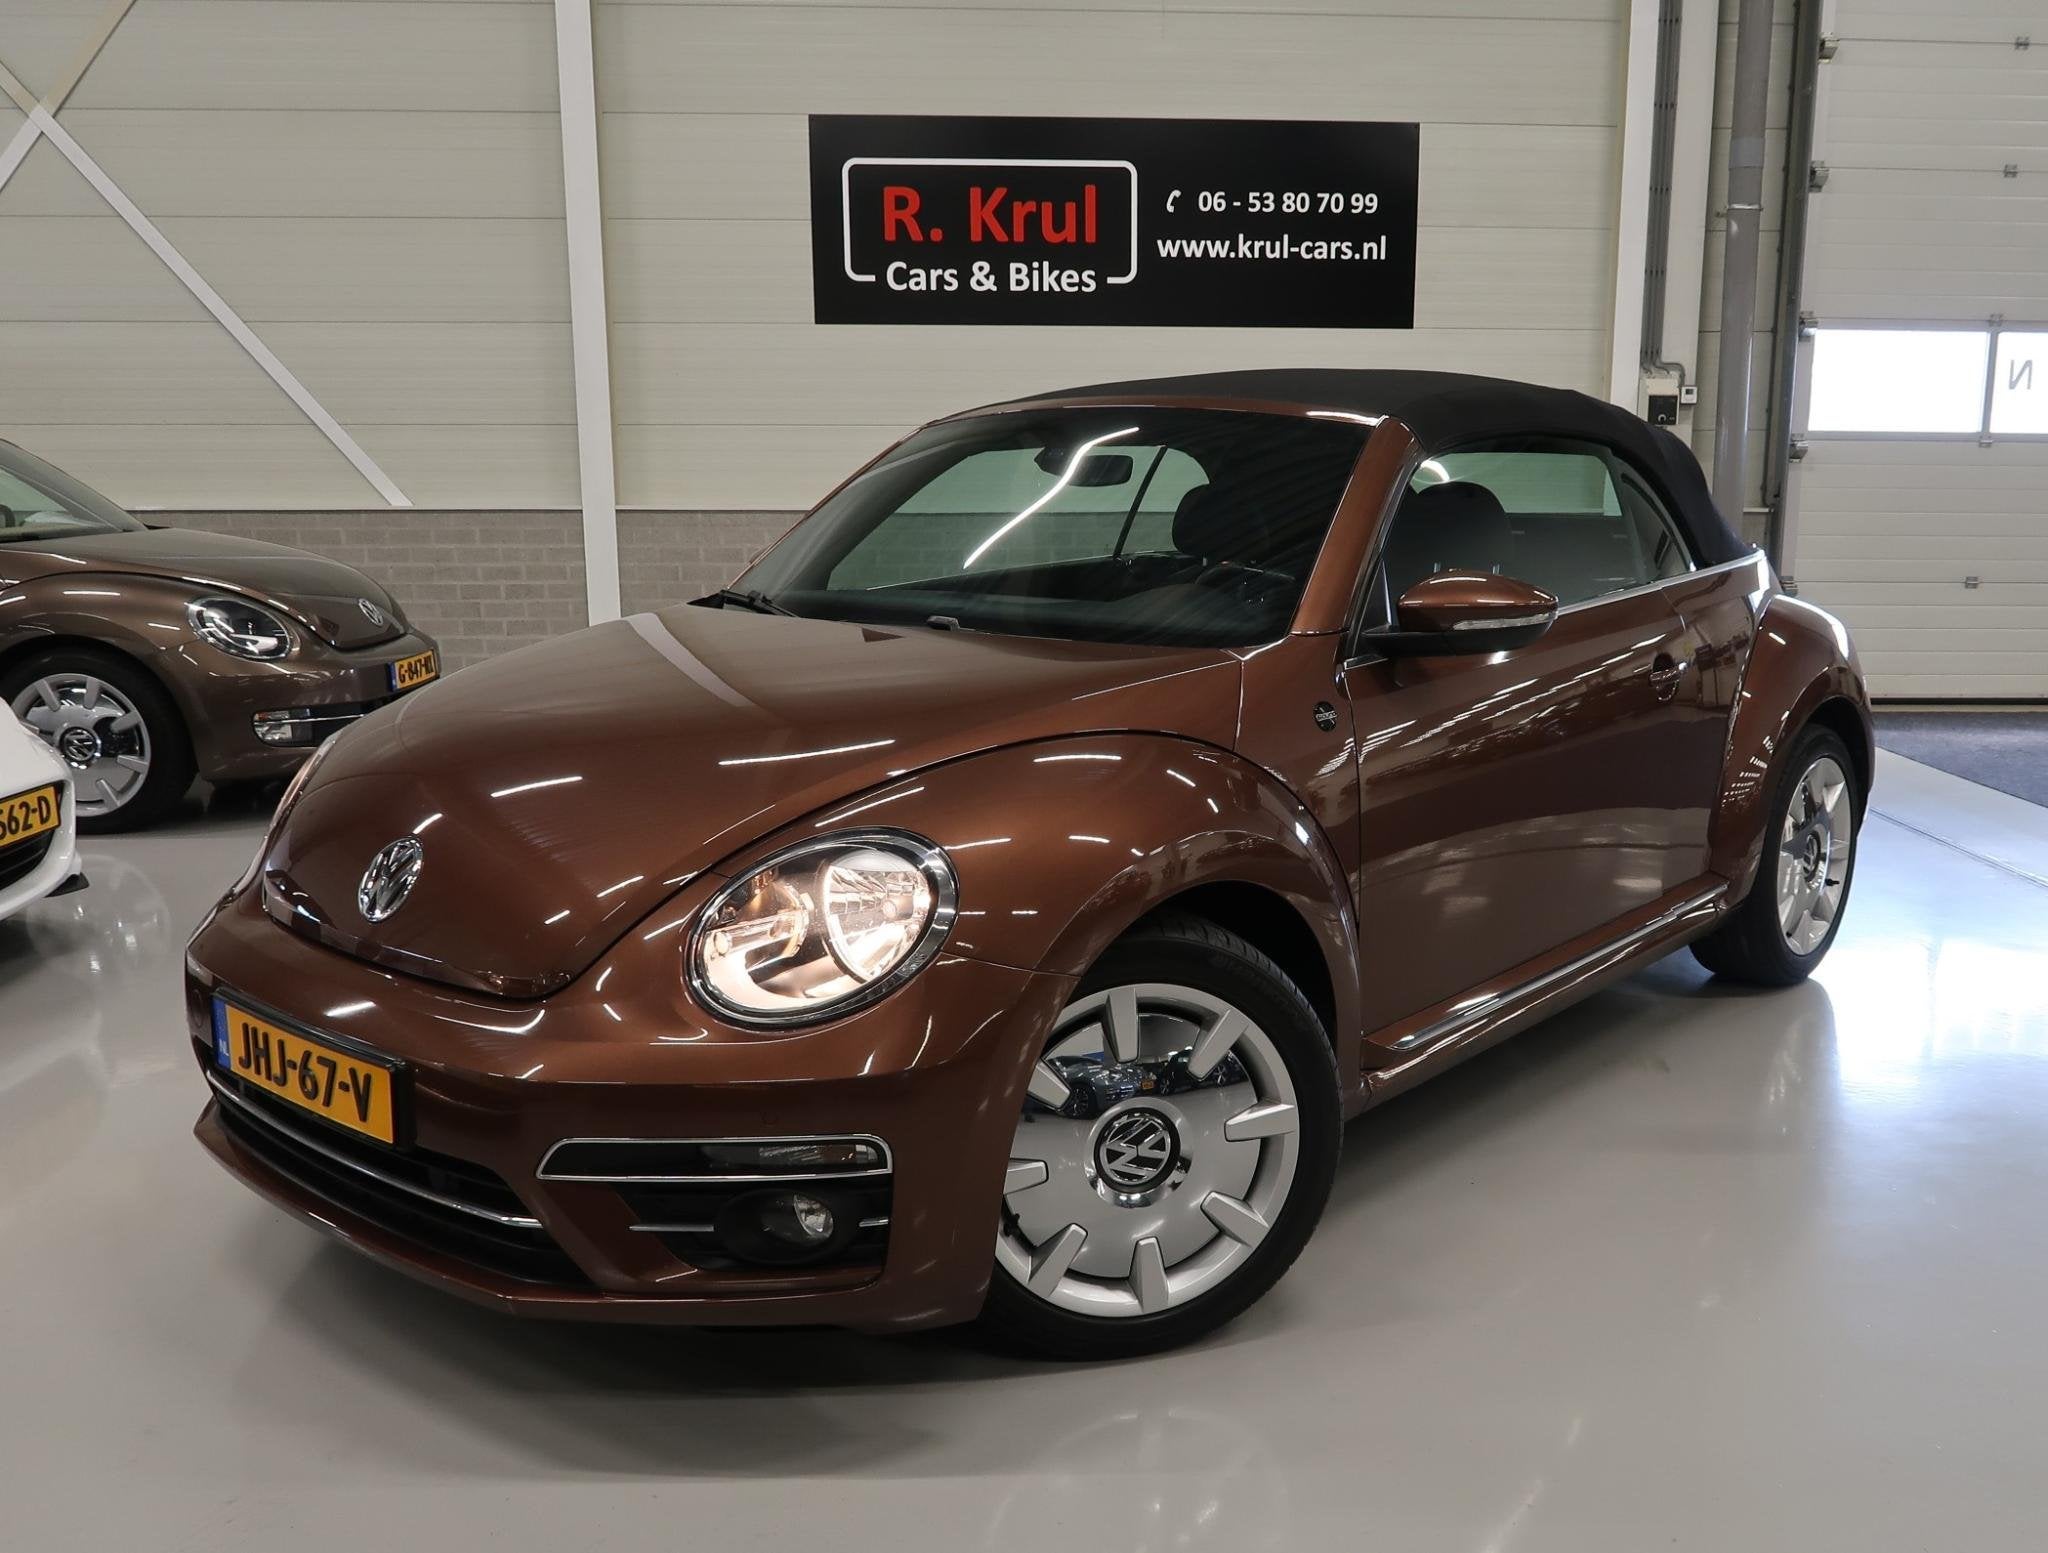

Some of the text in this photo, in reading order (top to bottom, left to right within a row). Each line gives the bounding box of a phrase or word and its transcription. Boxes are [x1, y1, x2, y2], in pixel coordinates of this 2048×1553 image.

[883, 185, 1096, 243] R. Krul
[1198, 191, 1227, 213] 06
[1247, 191, 1275, 213] 53
[1281, 191, 1310, 213] 80
[1316, 192, 1345, 214] 70
[1350, 192, 1378, 214] 99
[1157, 233, 1387, 261] www.krul-cars.nl
[886, 260, 1097, 293] Cars & Bikes
[238, 1022, 372, 1122] JHJ-67-V
